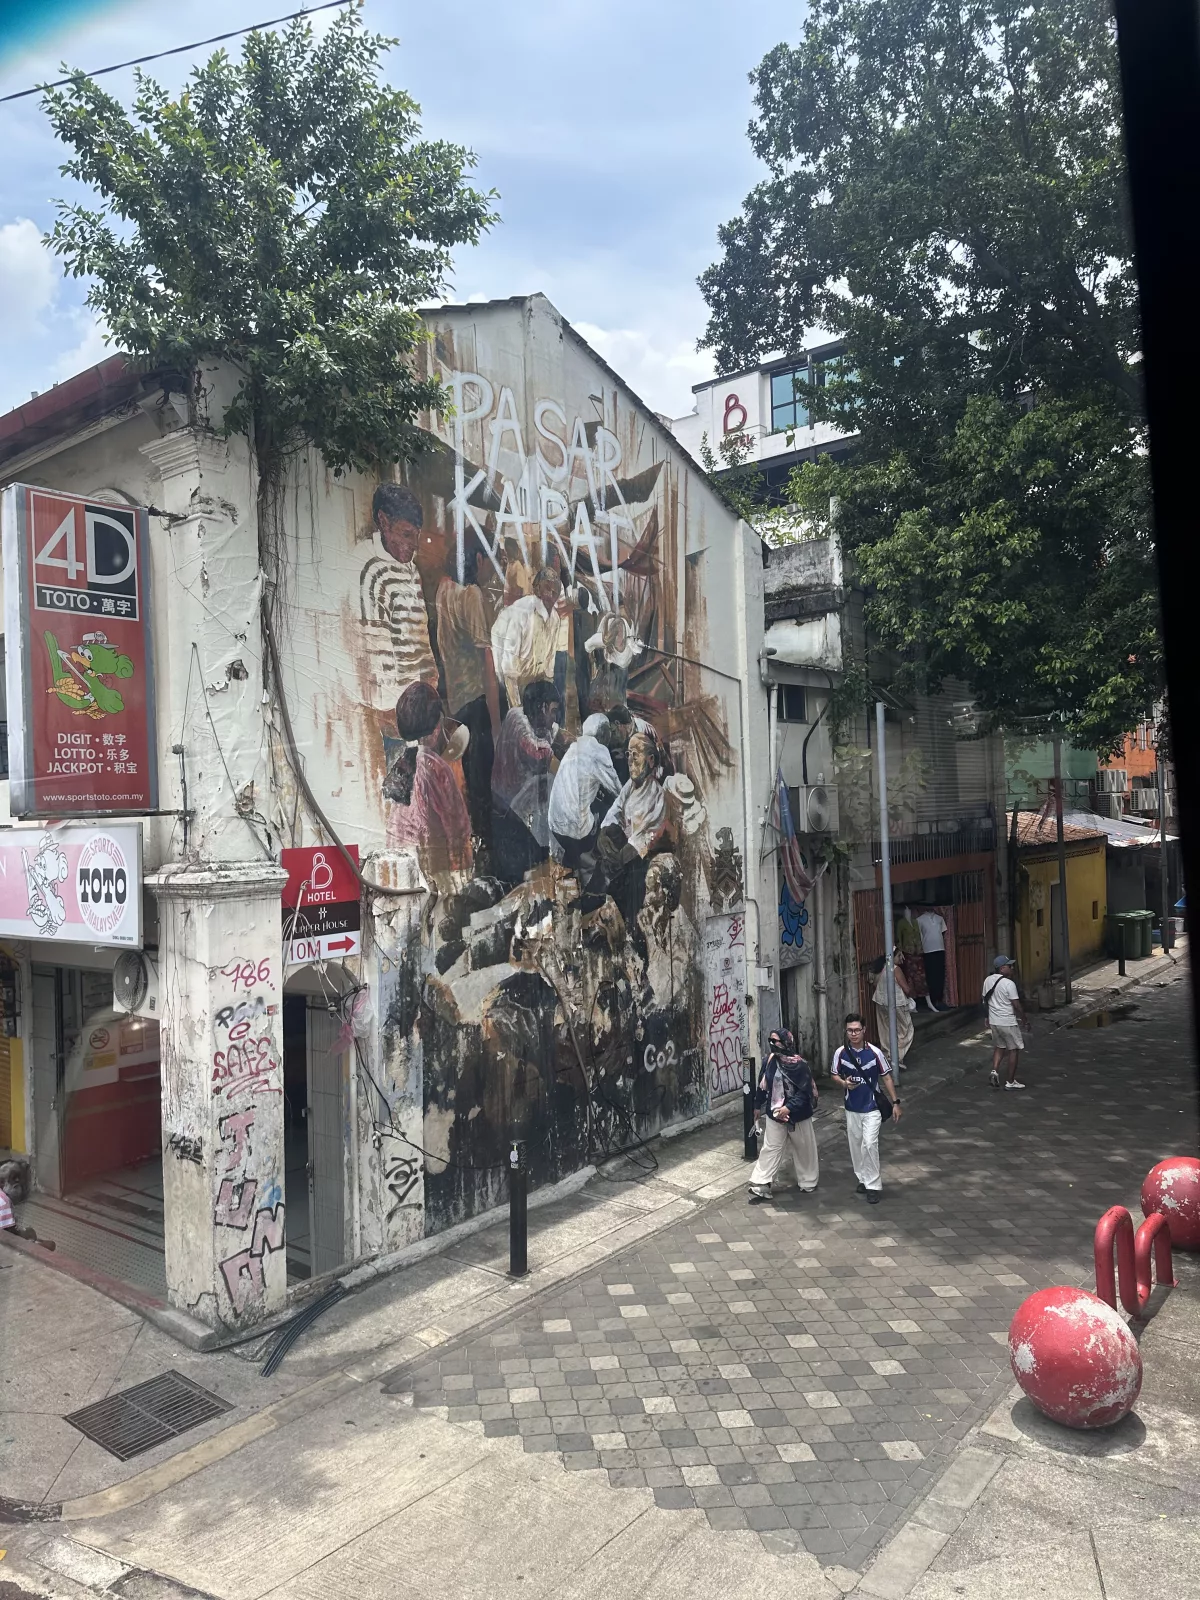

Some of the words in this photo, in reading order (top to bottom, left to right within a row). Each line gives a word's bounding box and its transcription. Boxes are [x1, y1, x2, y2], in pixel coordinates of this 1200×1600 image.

[444, 371, 638, 541] PASAR
[35, 506, 137, 585] 4D
[447, 465, 633, 613] KARAT
[42, 589, 90, 610] TOTO
[101, 598, 131, 615] 萬字
[57, 733, 92, 745] DIGIT
[102, 733, 127, 746] 数字
[54, 748, 96, 760] LOTTO
[106, 748, 130, 761] 乐多
[46, 762, 104, 774] JACKPOT
[113, 762, 138, 774] 积宝
[42, 793, 144, 802] www.sportstoto.com.my
[89, 837, 115, 857] SPORTS
[80, 868, 127, 905] TOTO
[307, 891, 337, 902] HOTEL
[86, 906, 119, 932] MALAYSIA
[322, 919, 349, 931] HOUSE
